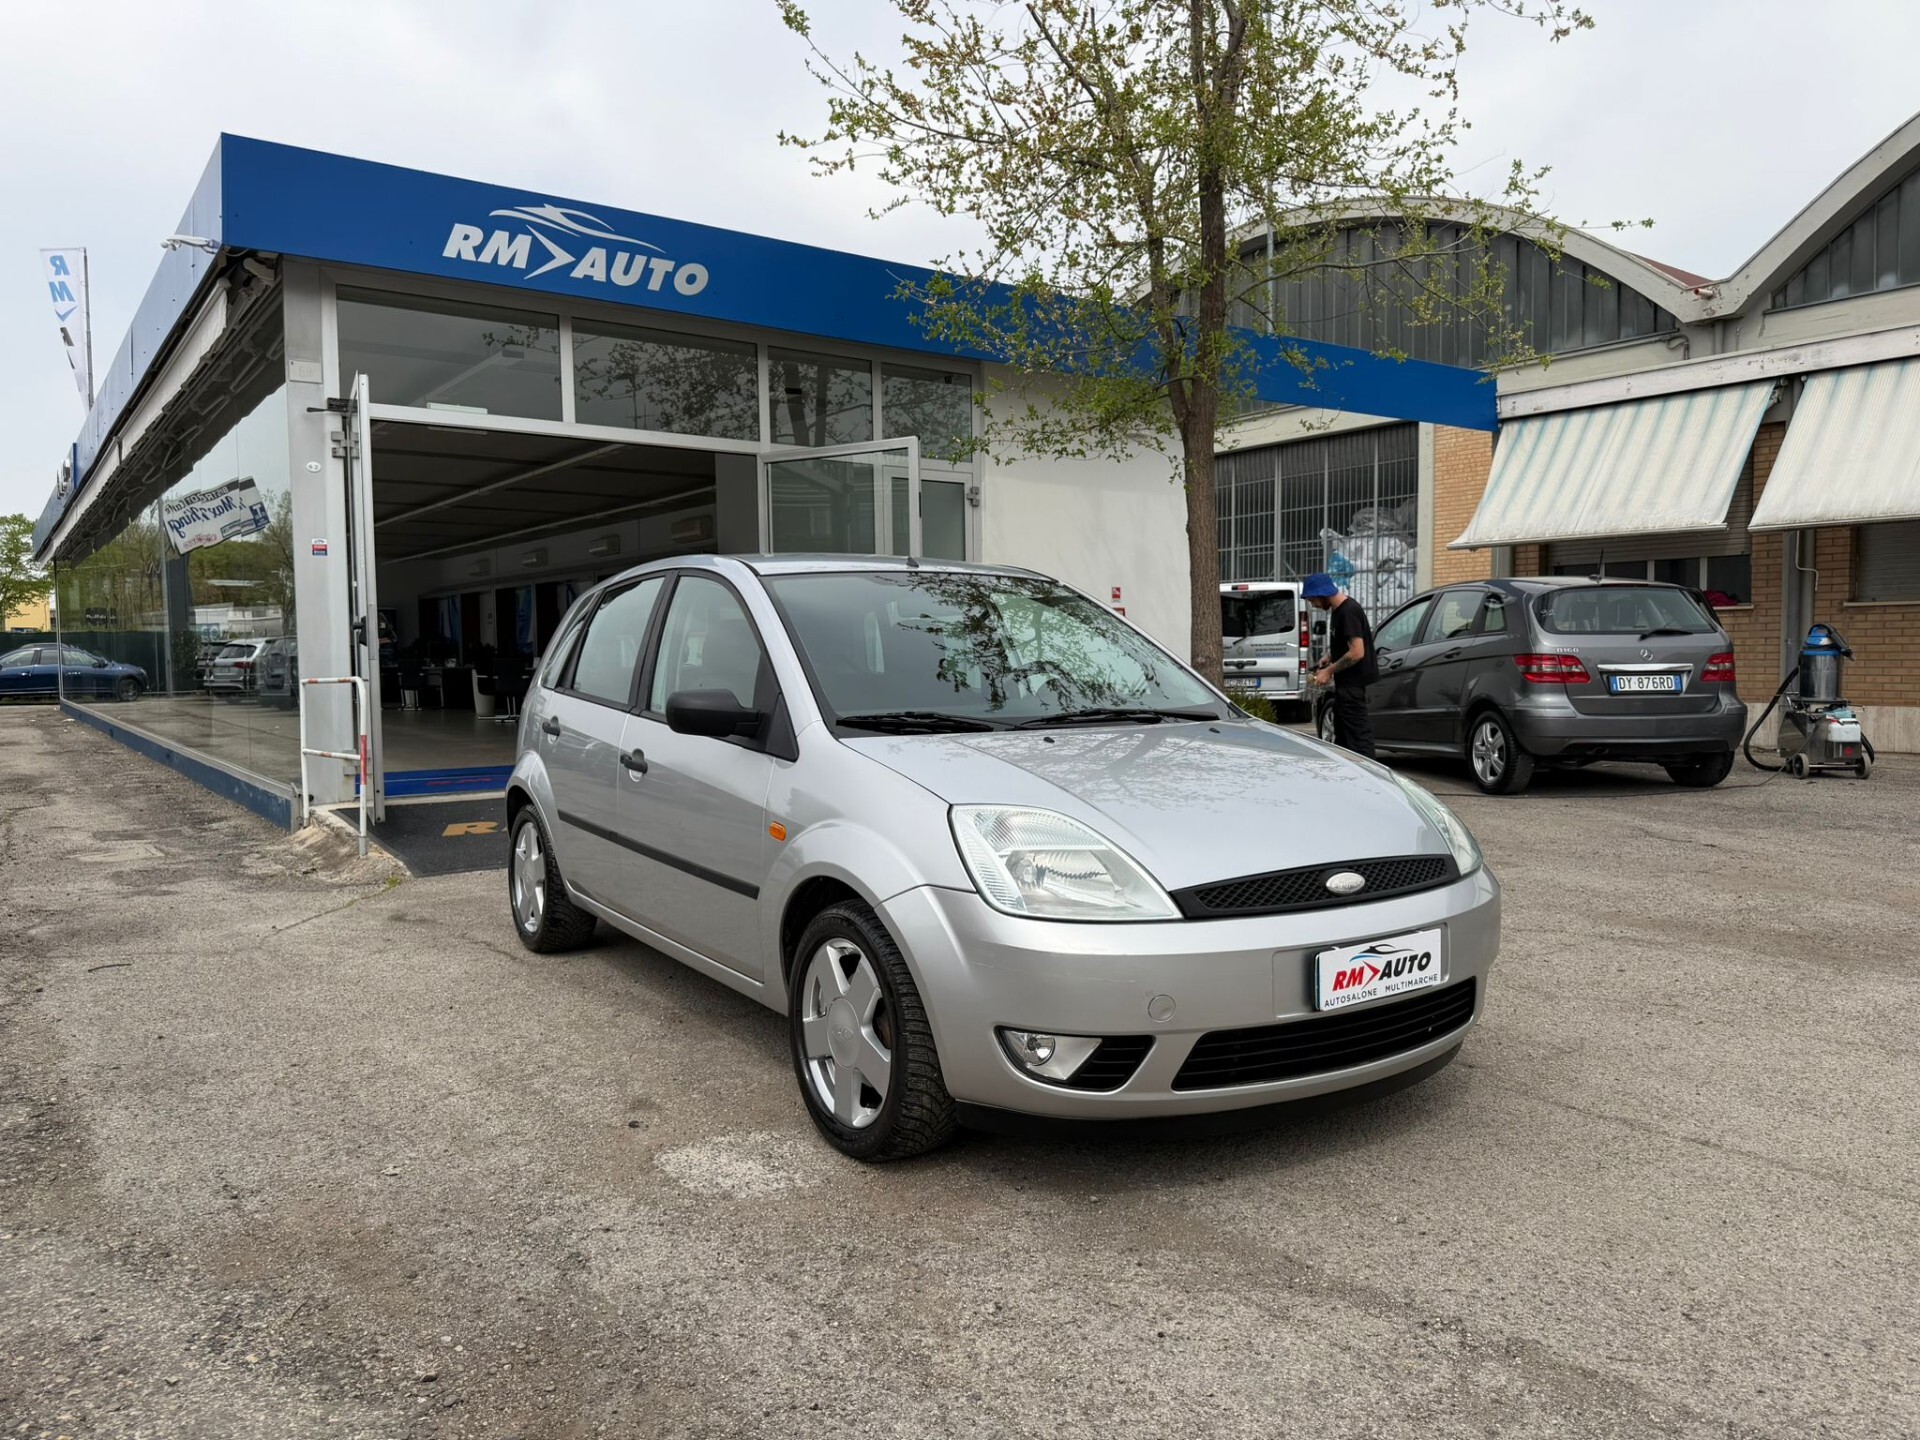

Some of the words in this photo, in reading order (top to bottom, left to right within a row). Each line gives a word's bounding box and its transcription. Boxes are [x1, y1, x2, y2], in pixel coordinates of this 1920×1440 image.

[442, 223, 532, 269] RM
[569, 246, 709, 296] AUTO
[1618, 677, 1634, 689] DY
[1638, 676, 1674, 689] 876RD
[1332, 966, 1365, 991] RM
[1378, 951, 1432, 981] AUTO
[1324, 988, 1377, 1007] AUTOSALONE
[1385, 973, 1438, 993] MULTIMARCHE
